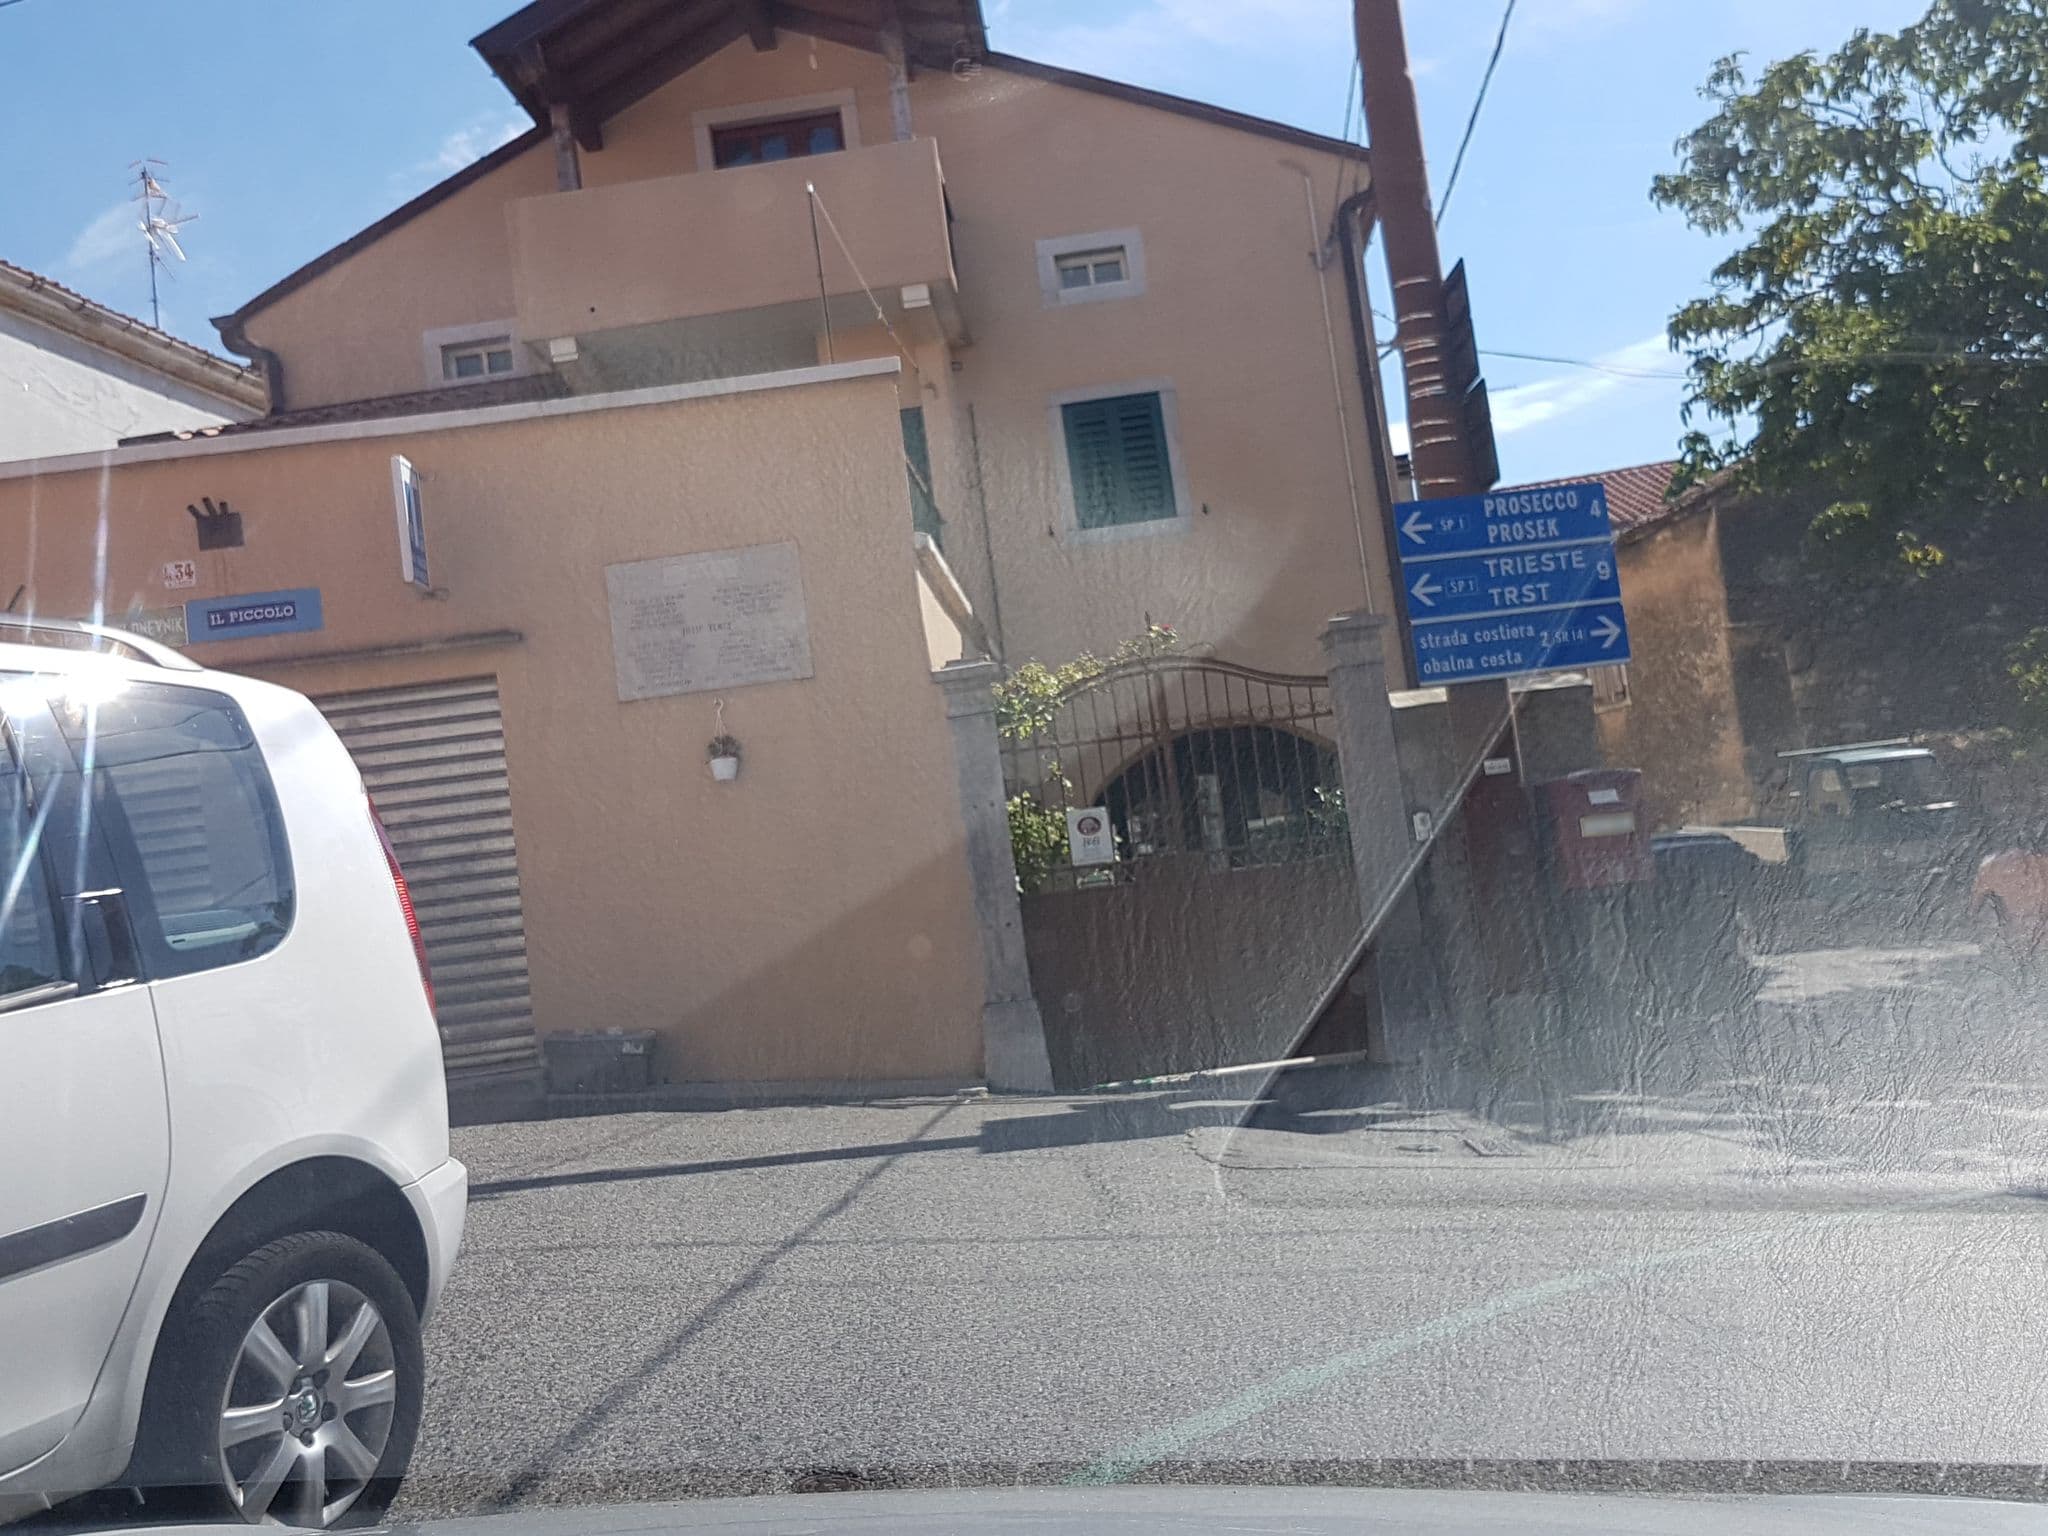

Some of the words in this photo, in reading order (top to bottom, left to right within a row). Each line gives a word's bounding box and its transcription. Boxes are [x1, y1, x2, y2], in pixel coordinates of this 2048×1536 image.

[1484, 491, 1578, 518] PROSECCO
[1590, 500, 1601, 518] 4
[1440, 519, 1454, 531] SP
[1487, 518, 1560, 544] PROSEK
[1484, 550, 1586, 578] TRIESTE
[1450, 579, 1465, 593] SP
[1488, 583, 1549, 606] TRST
[208, 611, 225, 626] IL
[229, 604, 295, 624] PICCOLO
[1419, 628, 1468, 649] strada
[1474, 623, 1535, 642] costiera
[1423, 653, 1474, 674] obalna
[1481, 650, 1523, 668] cesta
